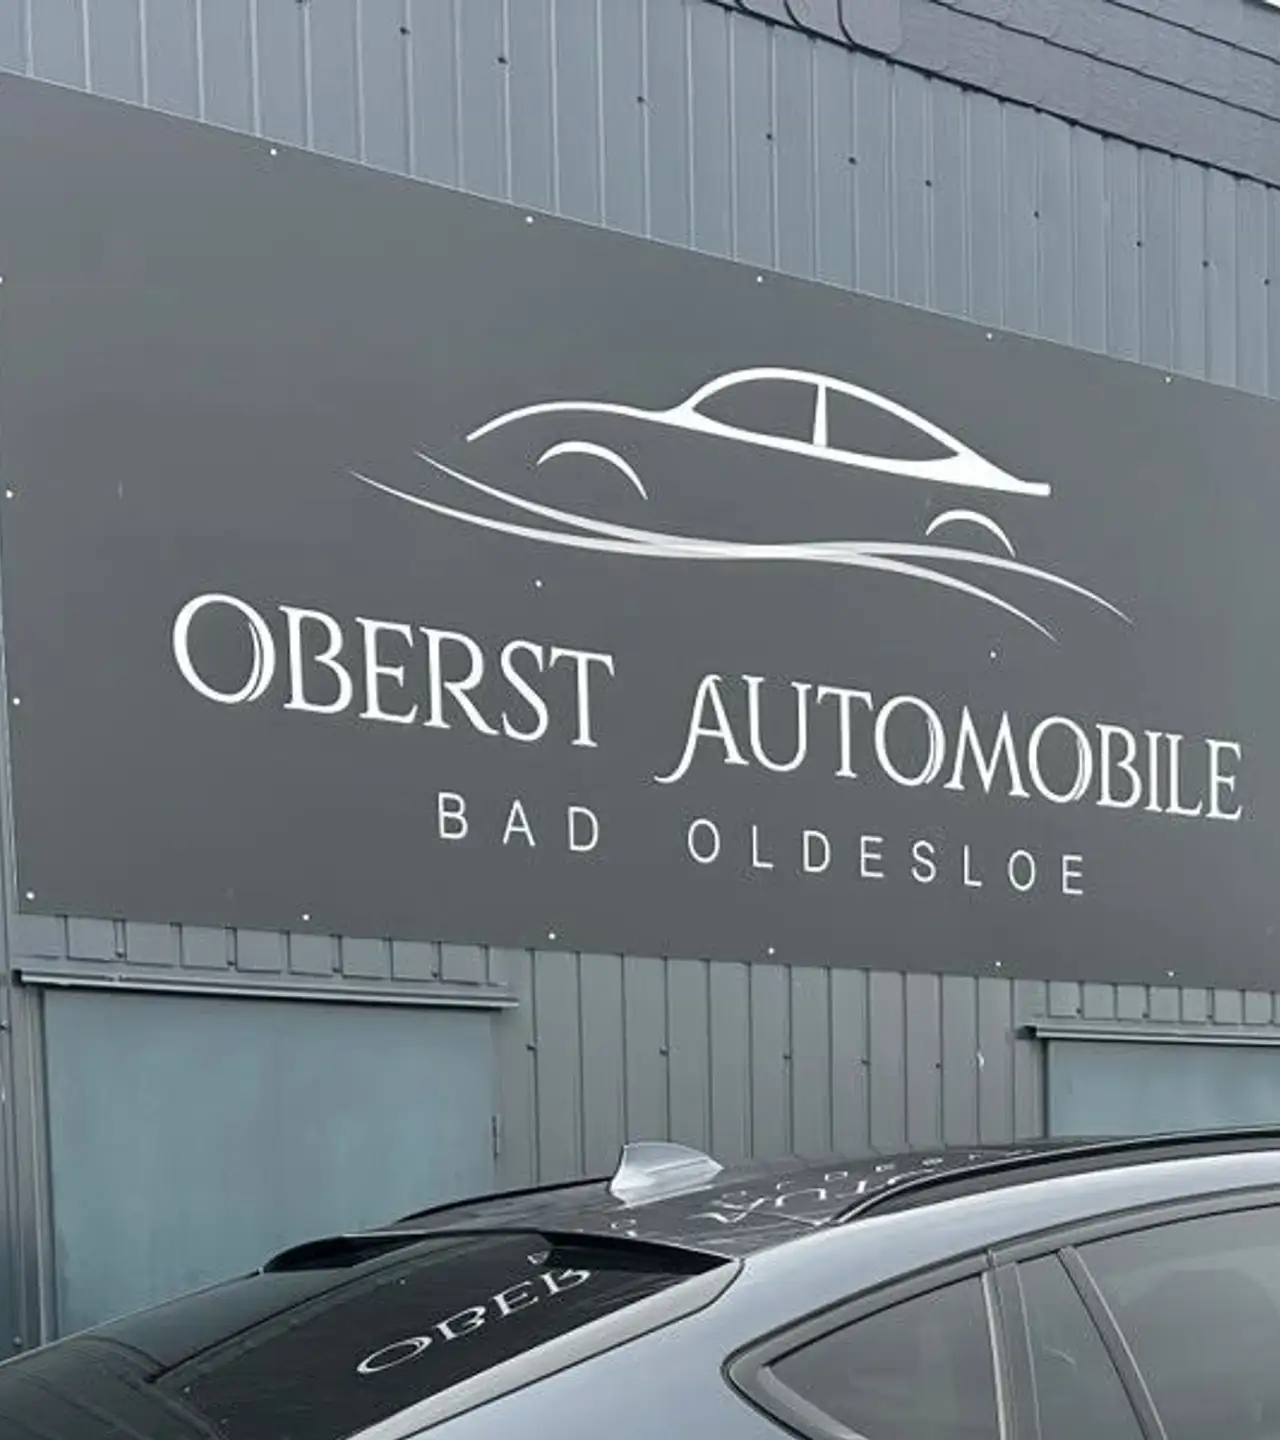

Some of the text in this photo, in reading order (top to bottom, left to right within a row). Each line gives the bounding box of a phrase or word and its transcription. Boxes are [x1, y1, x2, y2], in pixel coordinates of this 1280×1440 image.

[172, 593, 1243, 822] OBERST AUTOMOBILE
[438, 791, 1084, 896] BAD OLDESLOE
